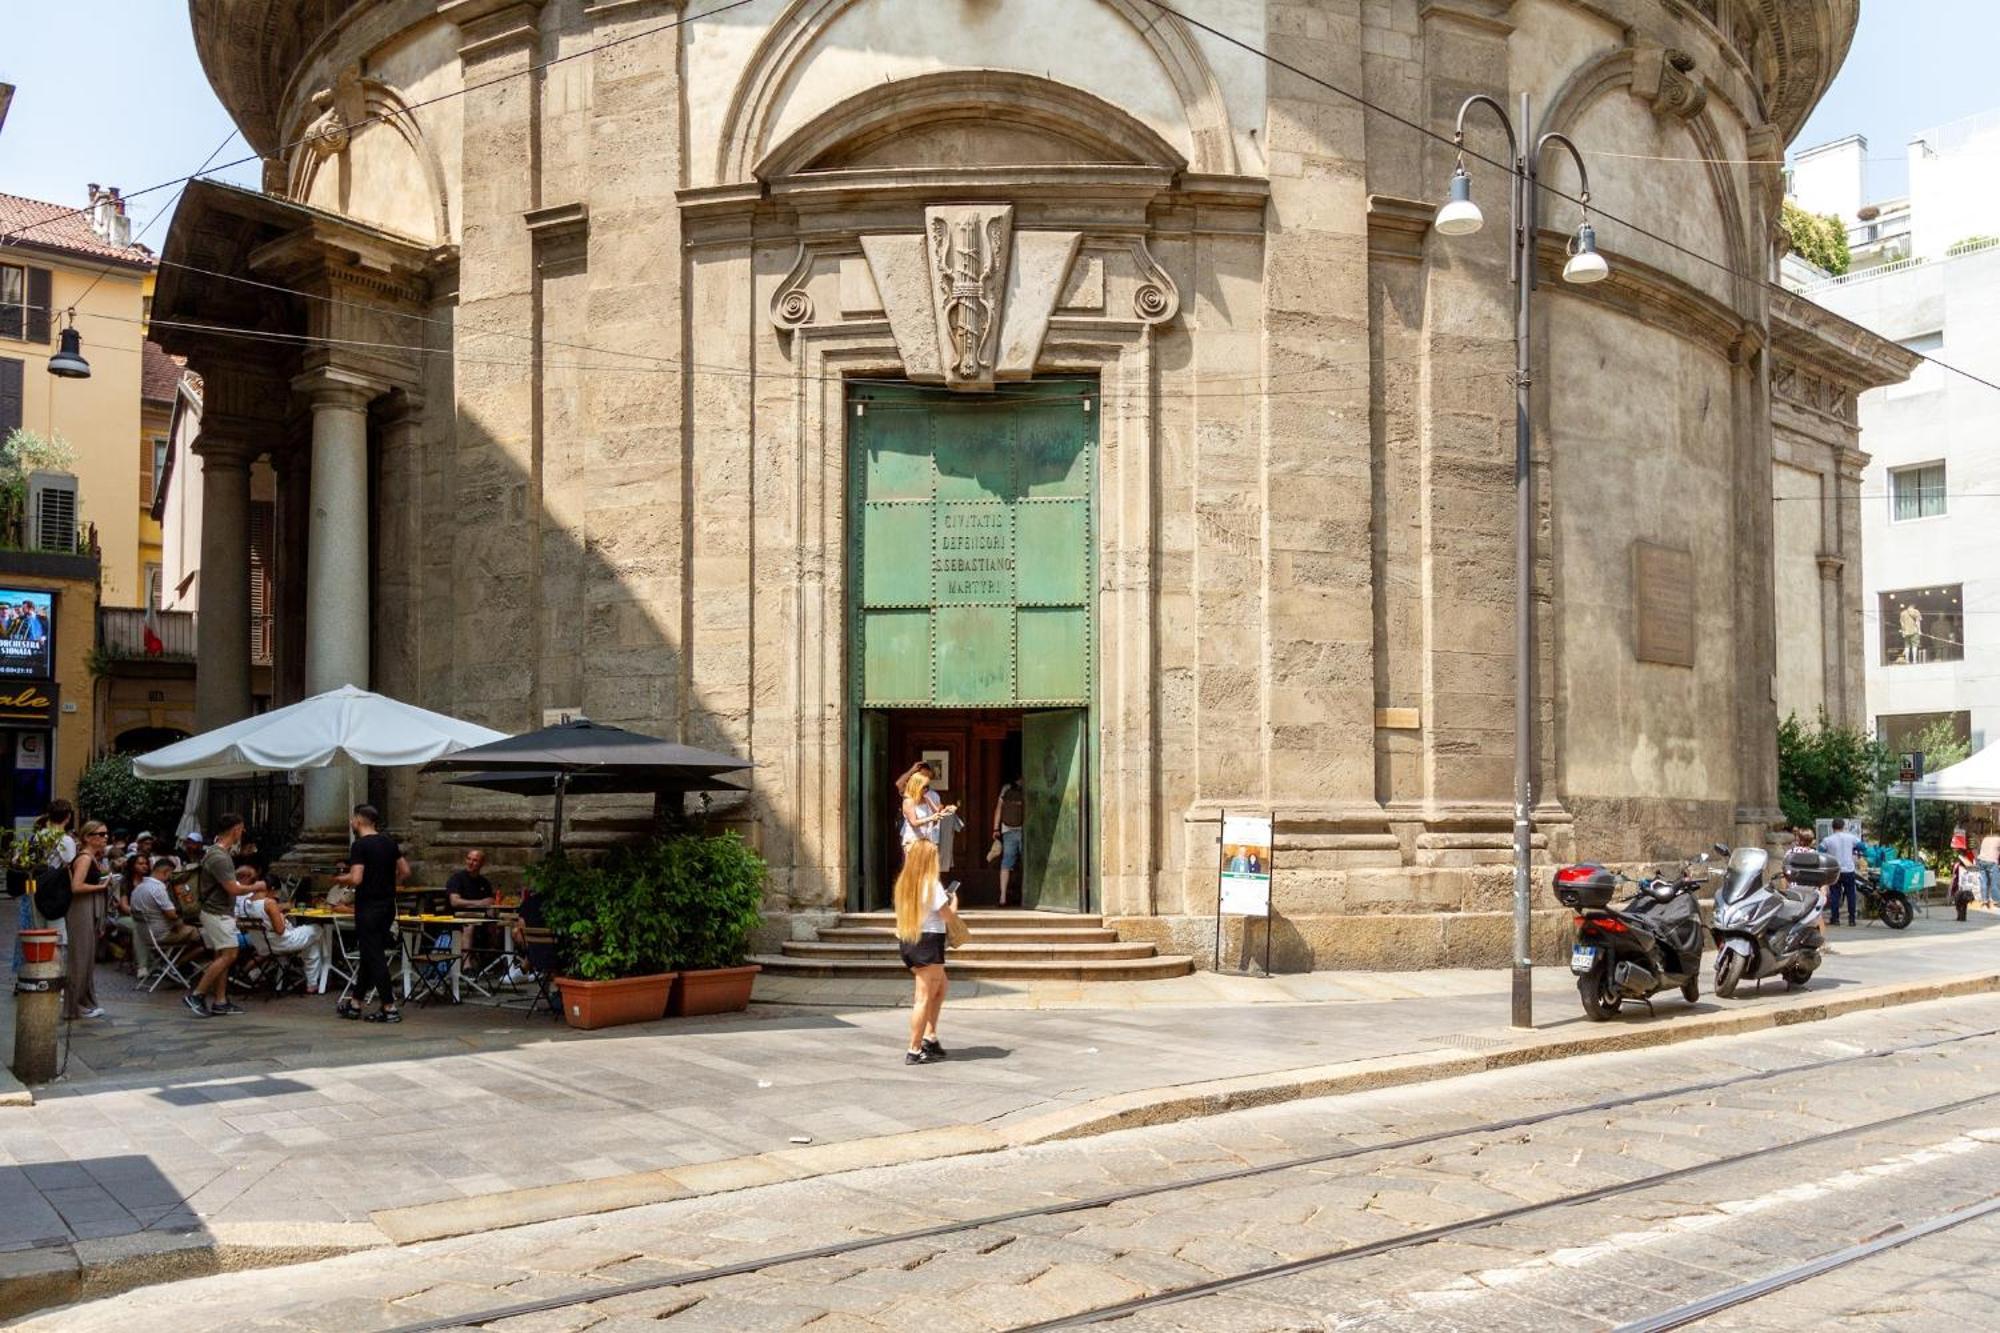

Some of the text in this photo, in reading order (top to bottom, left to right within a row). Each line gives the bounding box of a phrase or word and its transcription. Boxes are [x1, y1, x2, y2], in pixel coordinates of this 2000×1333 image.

[945, 514, 1002, 529] CIVITATIS
[942, 536, 1005, 550] DEFENSORI
[948, 580, 1001, 594] MARTYRI
